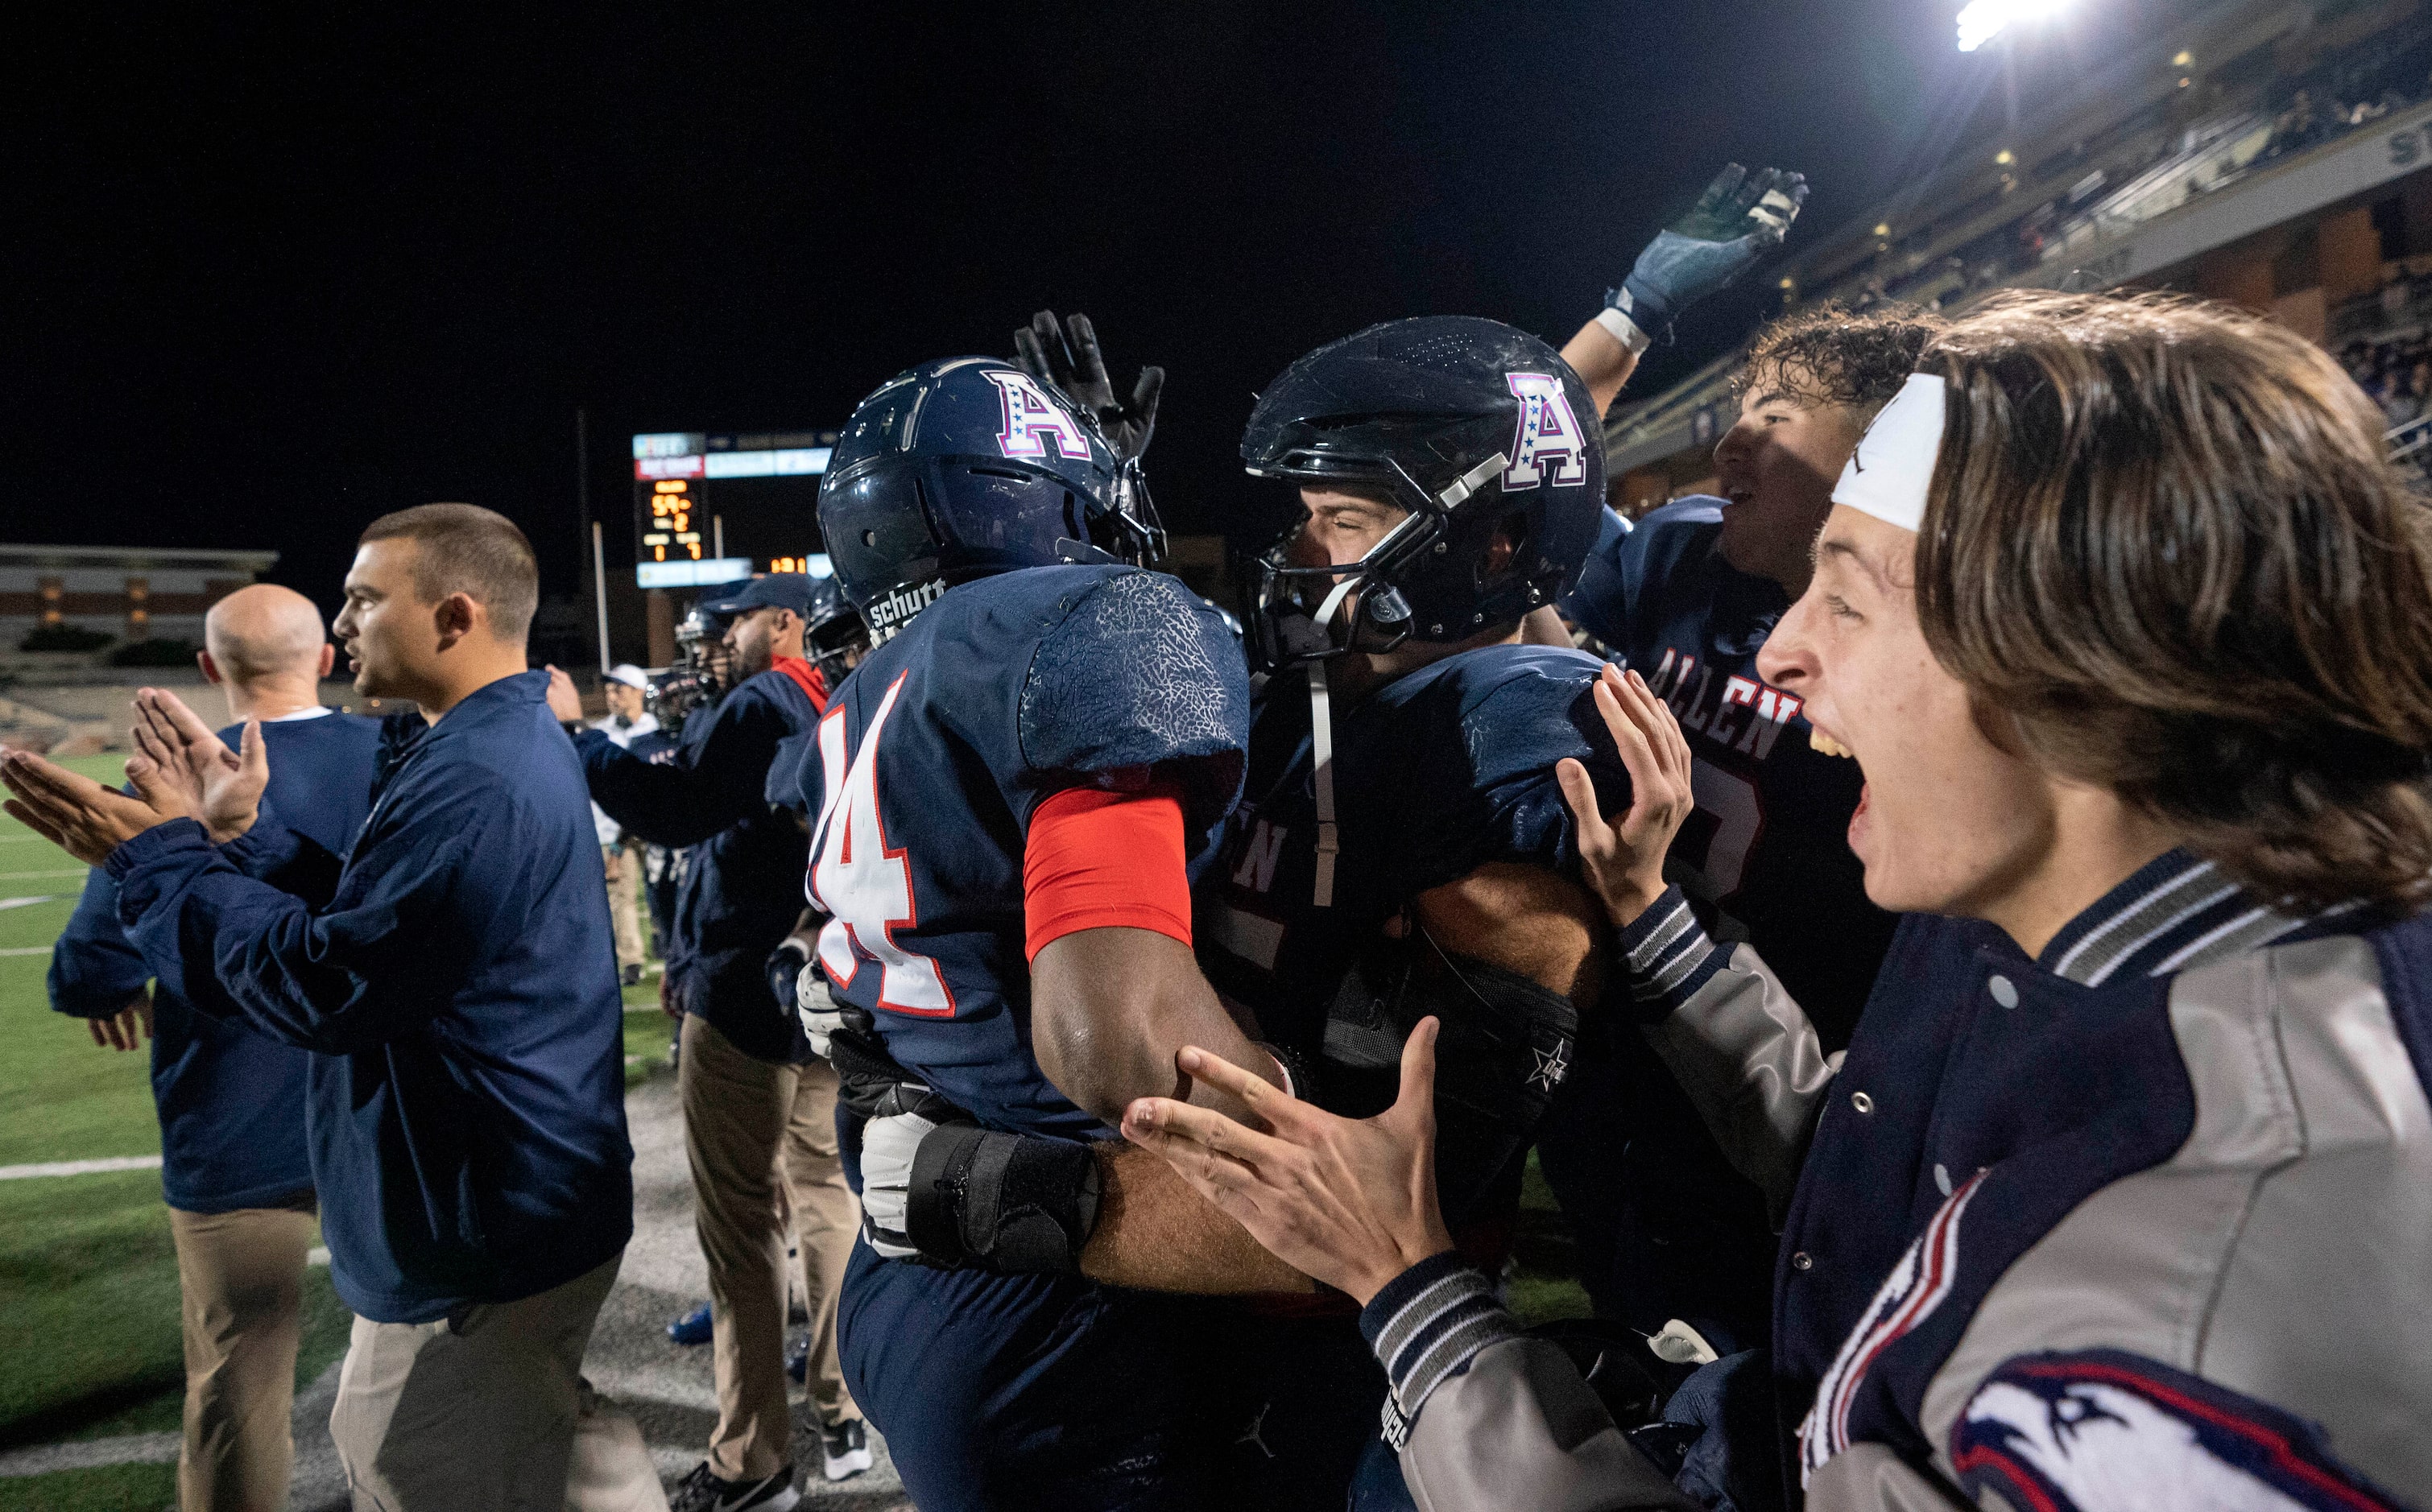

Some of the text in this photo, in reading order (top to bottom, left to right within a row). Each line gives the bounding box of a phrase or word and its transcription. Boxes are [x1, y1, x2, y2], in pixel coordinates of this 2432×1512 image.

[979, 370, 1092, 461] A
[1501, 372, 1586, 493] A
[870, 577, 946, 628] schutt
[1644, 647, 1805, 760] ALLEN
